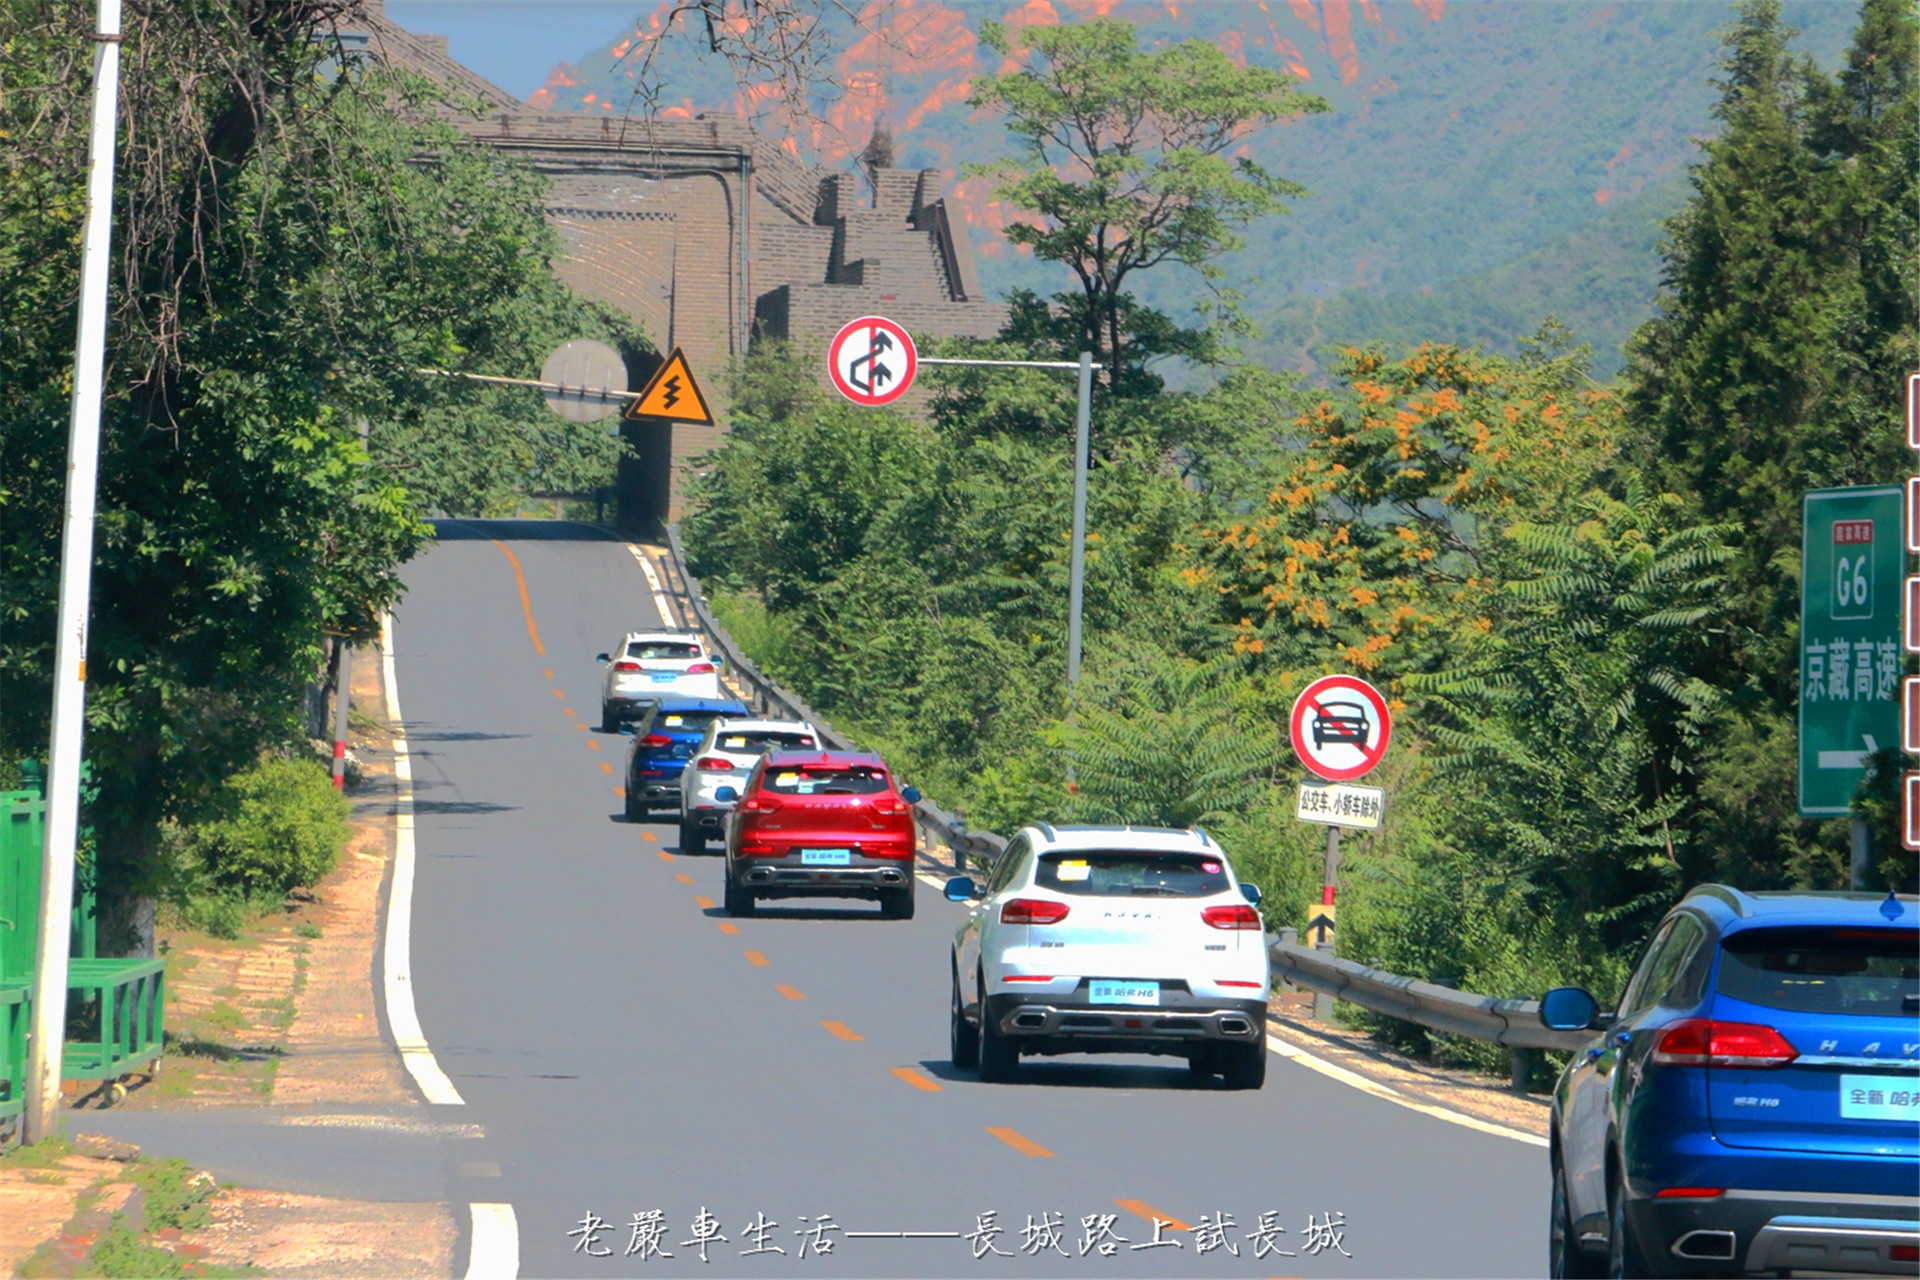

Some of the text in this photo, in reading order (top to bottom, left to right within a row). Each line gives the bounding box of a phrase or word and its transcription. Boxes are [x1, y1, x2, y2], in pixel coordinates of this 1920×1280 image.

[1836, 555, 1868, 606] G6
[1805, 637, 1898, 701] 京藏高速
[1850, 1089, 1884, 1105] 全新
